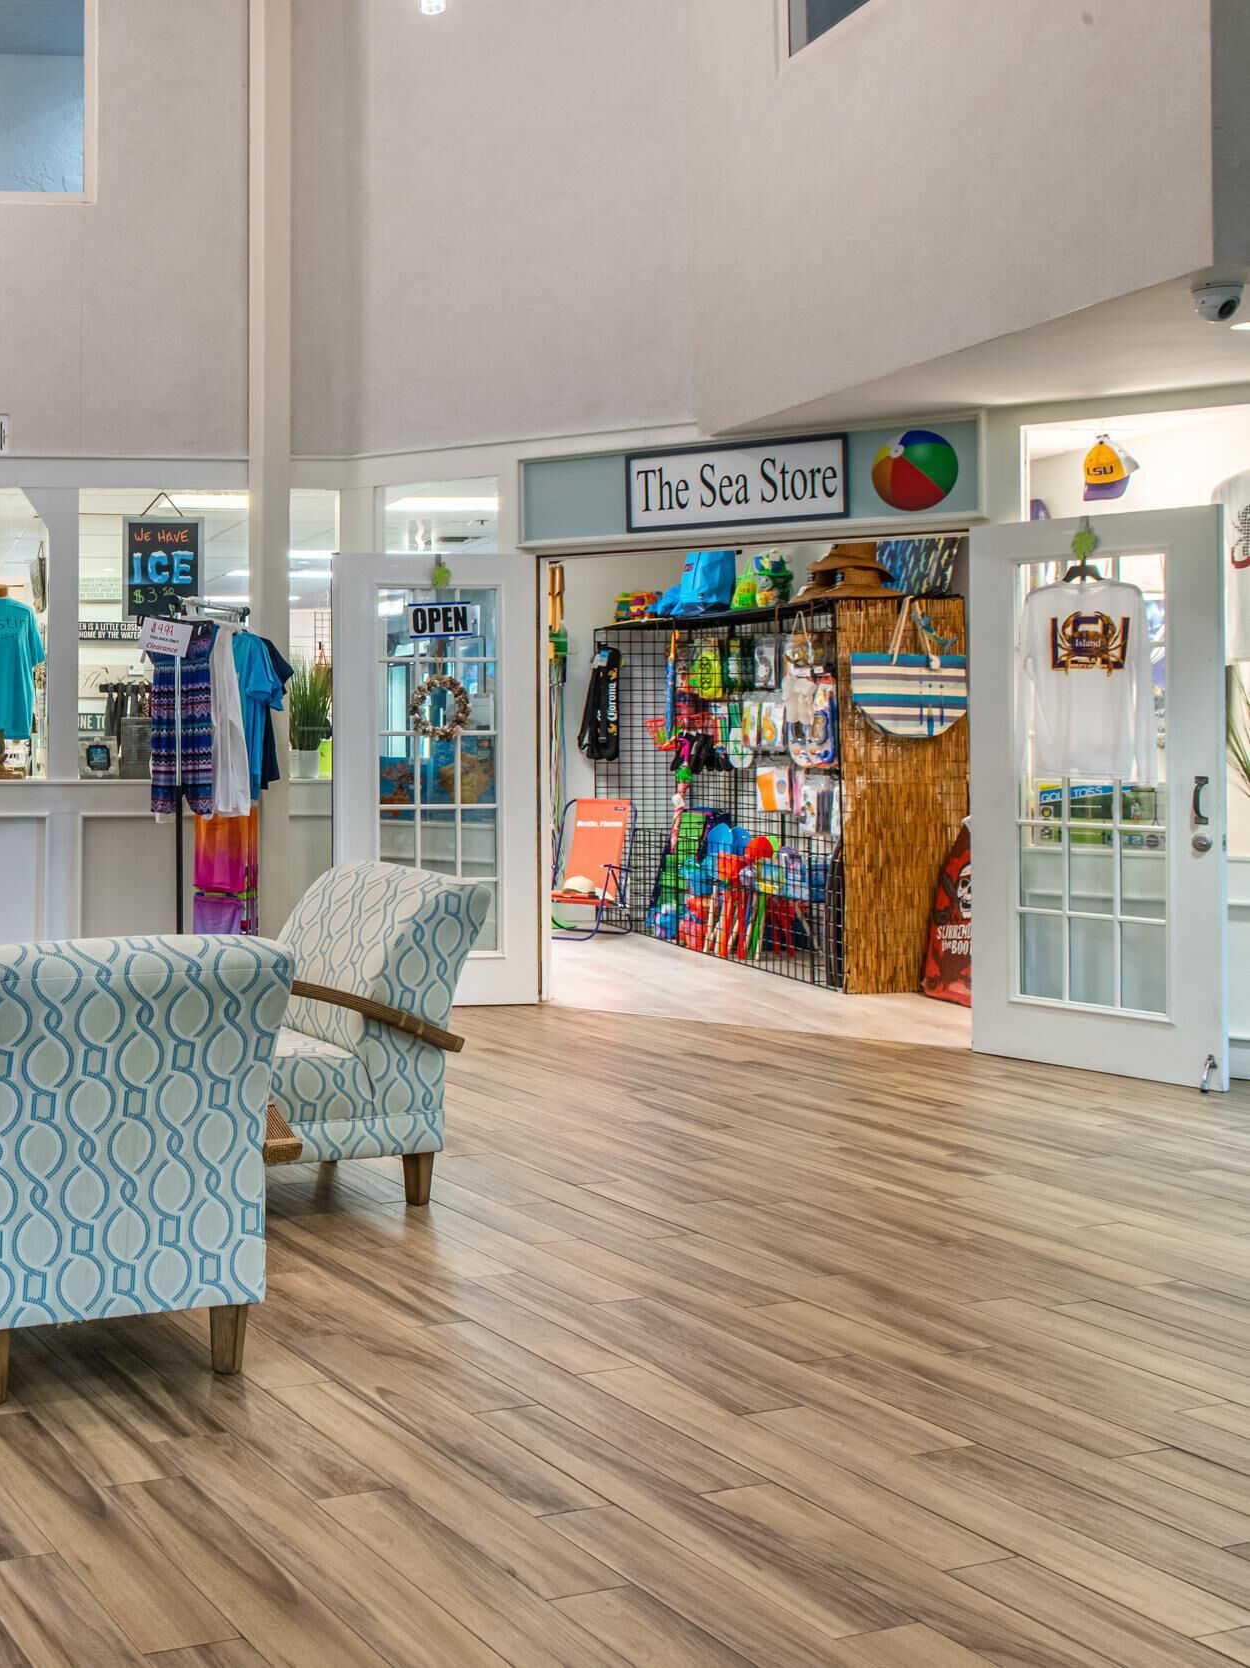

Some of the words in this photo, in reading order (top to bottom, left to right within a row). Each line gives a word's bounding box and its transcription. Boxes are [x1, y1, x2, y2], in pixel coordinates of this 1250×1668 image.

[1086, 465, 1114, 476] LSU
[636, 467, 690, 512] The
[699, 463, 750, 508] Sea
[760, 457, 838, 503] Store
[134, 528, 152, 541] WE
[157, 529, 189, 542] HAVE
[132, 550, 195, 585] ICE
[88, 623, 94, 631] IS
[95, 623, 100, 631] A
[100, 623, 120, 631] LITTLE
[412, 606, 469, 634] OPEN
[79, 631, 97, 639] HOME
[98, 631, 106, 639] BY
[107, 631, 120, 639] THE
[146, 642, 178, 653] Clearance
[1075, 639, 1102, 648] Island
[606, 683, 618, 722] Corona
[78, 714, 94, 730] NE
[1041, 791, 1062, 802] GOL
[1072, 786, 1103, 798] TOSS
